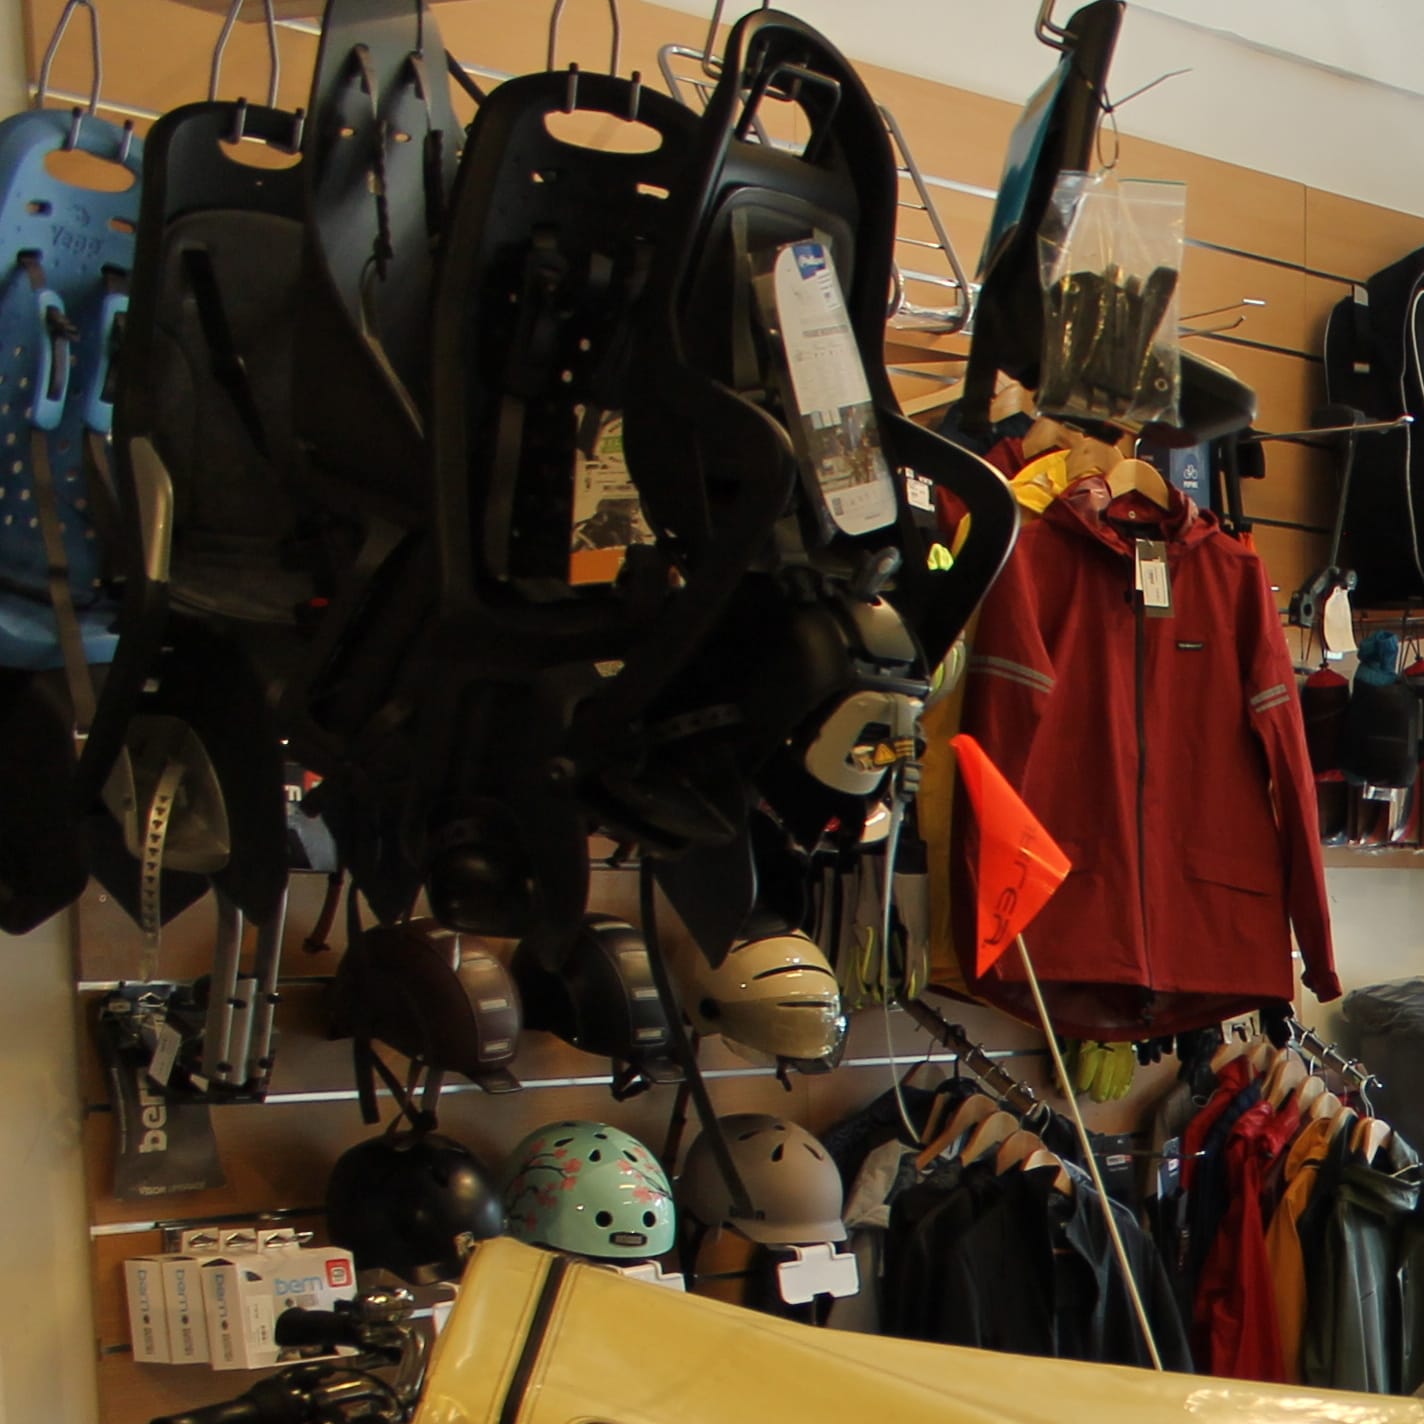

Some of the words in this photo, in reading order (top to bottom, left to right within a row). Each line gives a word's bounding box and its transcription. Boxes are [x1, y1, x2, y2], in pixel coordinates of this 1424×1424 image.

[139, 1080, 168, 1153] ber
[137, 1269, 150, 1313] bern
[175, 1267, 188, 1312] bern
[213, 1272, 228, 1317] bern
[274, 1275, 324, 1295] bern
